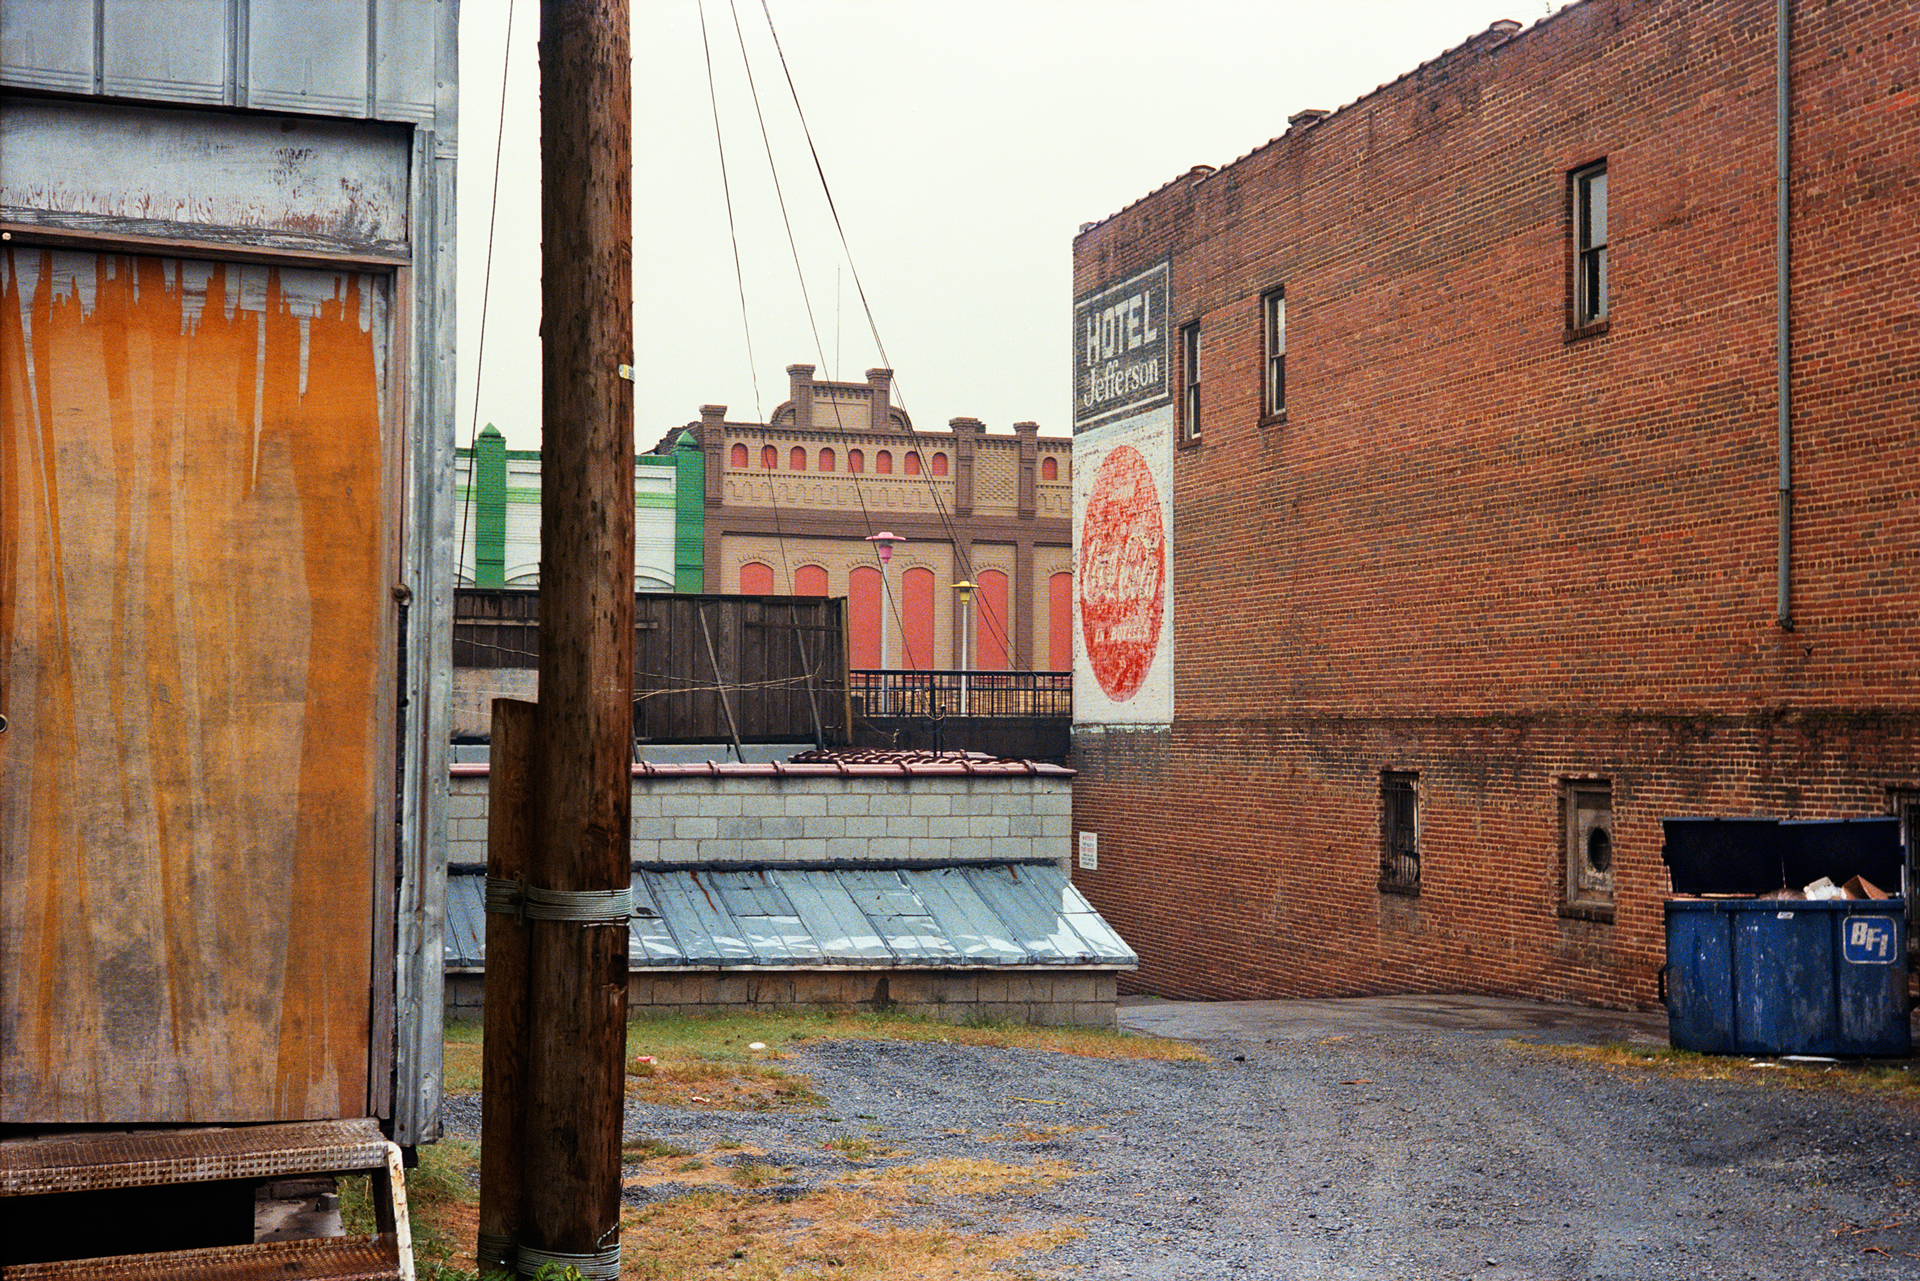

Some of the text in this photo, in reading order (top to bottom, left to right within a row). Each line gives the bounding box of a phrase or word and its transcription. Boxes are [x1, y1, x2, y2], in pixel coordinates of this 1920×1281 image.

[1086, 290, 1157, 367] HOTEL
[1083, 358, 1159, 407] Jefferson
[1850, 922, 1889, 957] BFI
